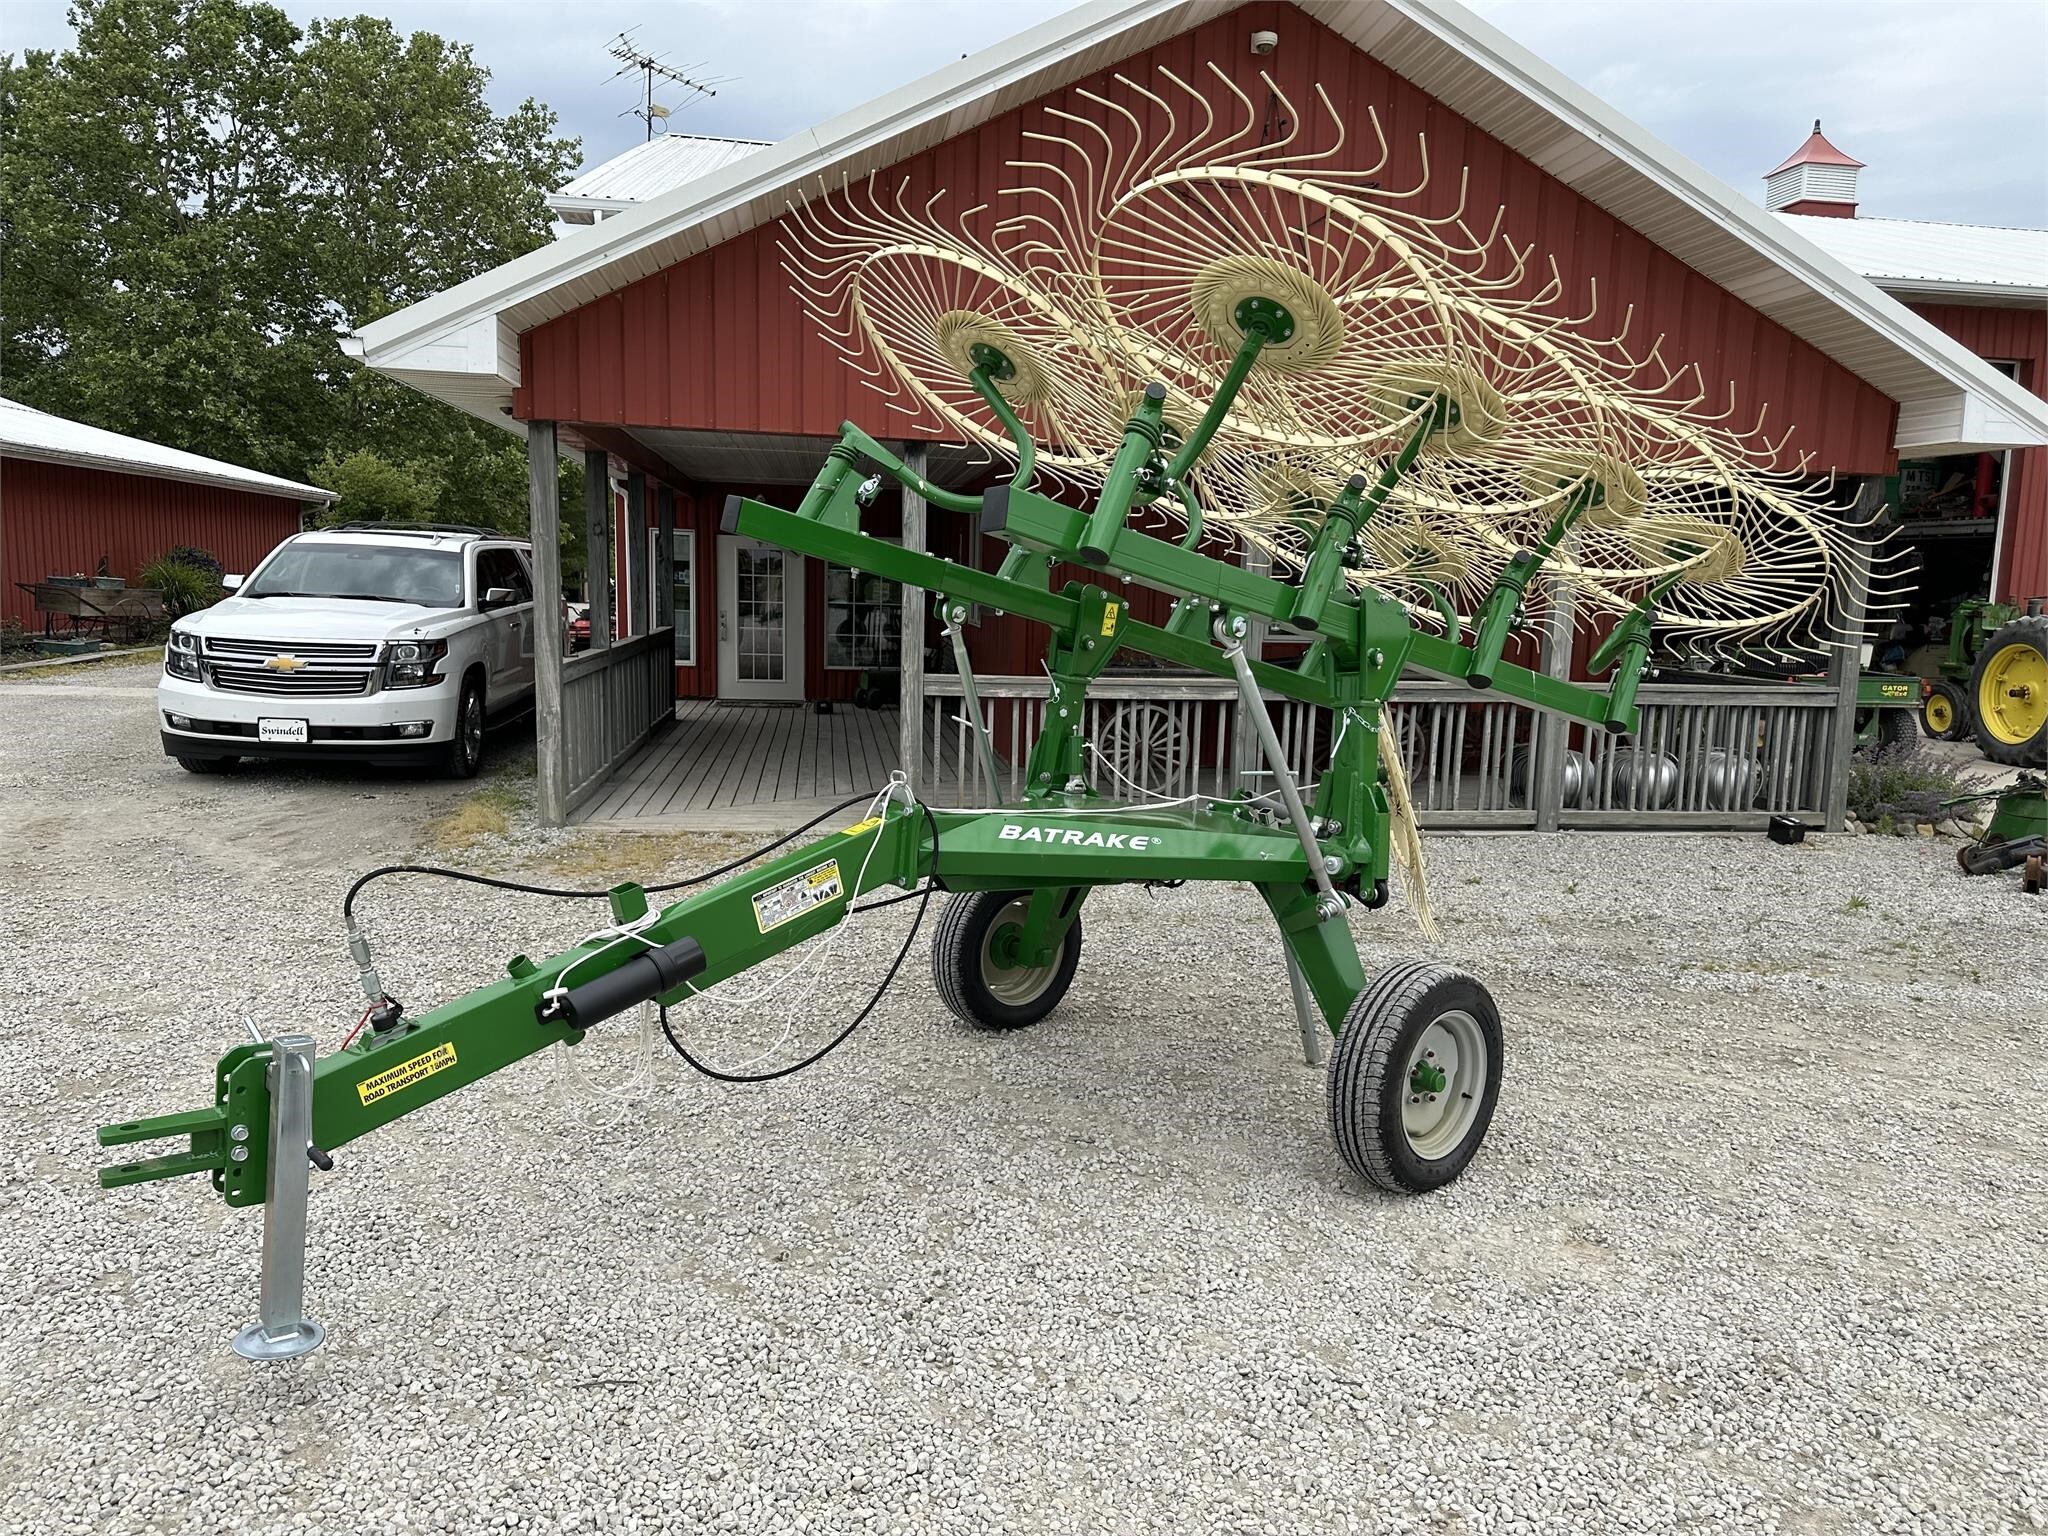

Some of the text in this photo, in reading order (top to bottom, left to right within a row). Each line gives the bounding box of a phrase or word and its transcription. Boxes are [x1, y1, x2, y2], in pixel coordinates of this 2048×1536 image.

[261, 726, 304, 736] Swindell
[363, 1088, 386, 1104] ROAD
[386, 1067, 429, 1093] TRANSPORT
[366, 1047, 449, 1091] MAXIMUM SPEED FOR
